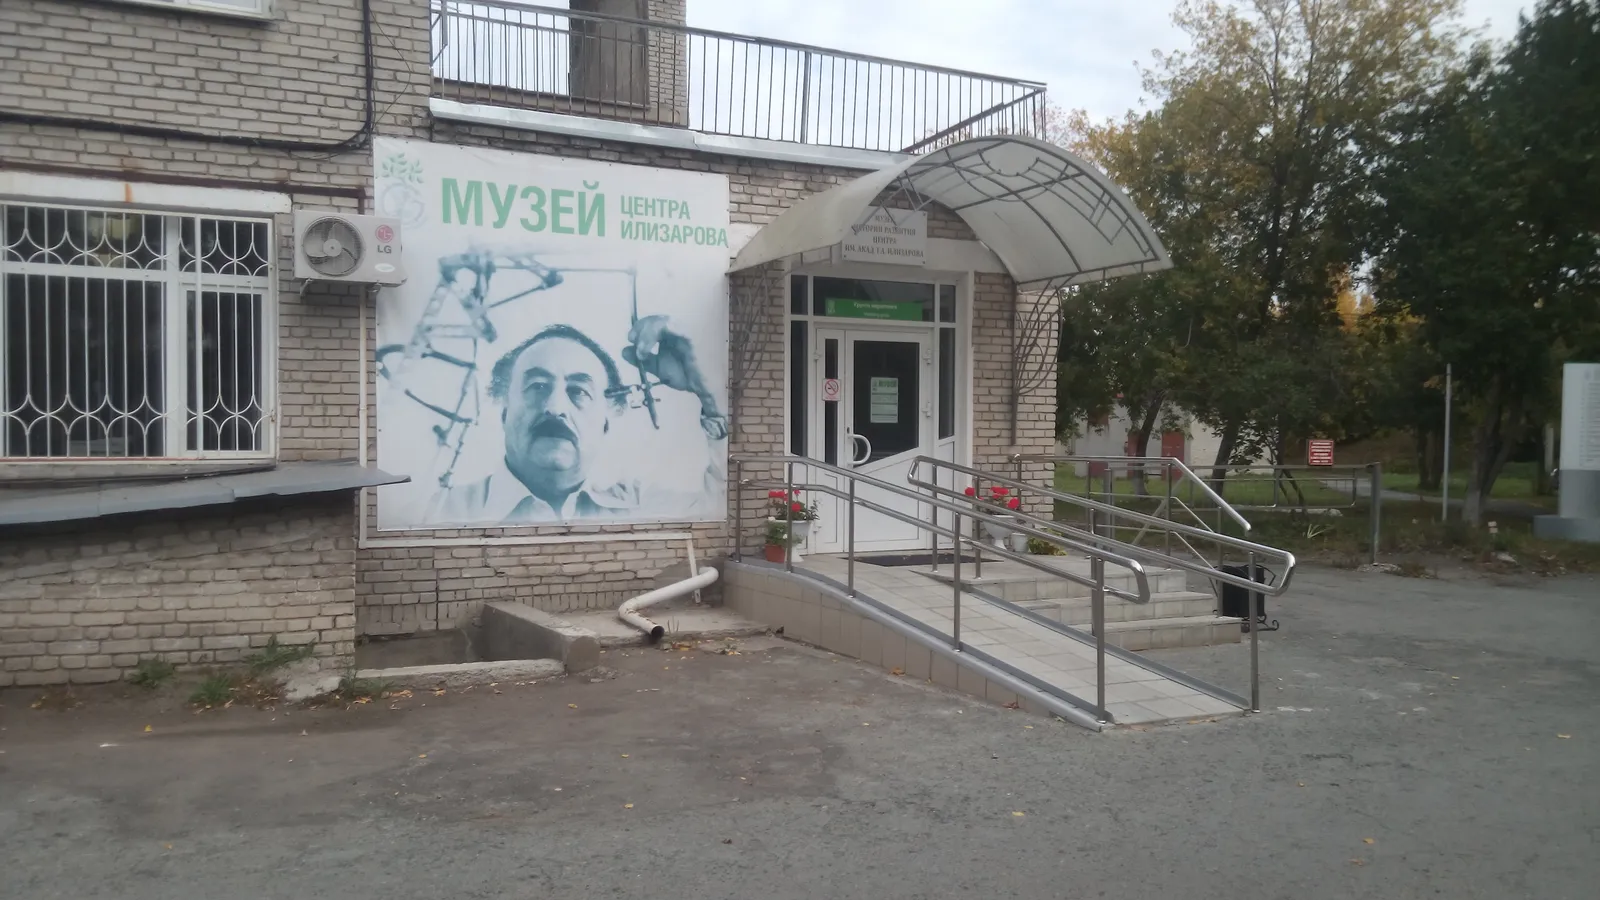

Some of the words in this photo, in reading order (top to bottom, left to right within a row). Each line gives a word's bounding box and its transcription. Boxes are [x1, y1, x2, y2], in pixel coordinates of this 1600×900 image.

[441, 177, 606, 237] МУЗЕЙ
[620, 195, 691, 220] ЦЕНТРА
[620, 220, 729, 248] ИЛИЗАРОВА
[872, 235, 897, 244] ЦЕНТРА
[377, 244, 392, 254] LG
[887, 247, 924, 258] ИЛИЗАРОВА
